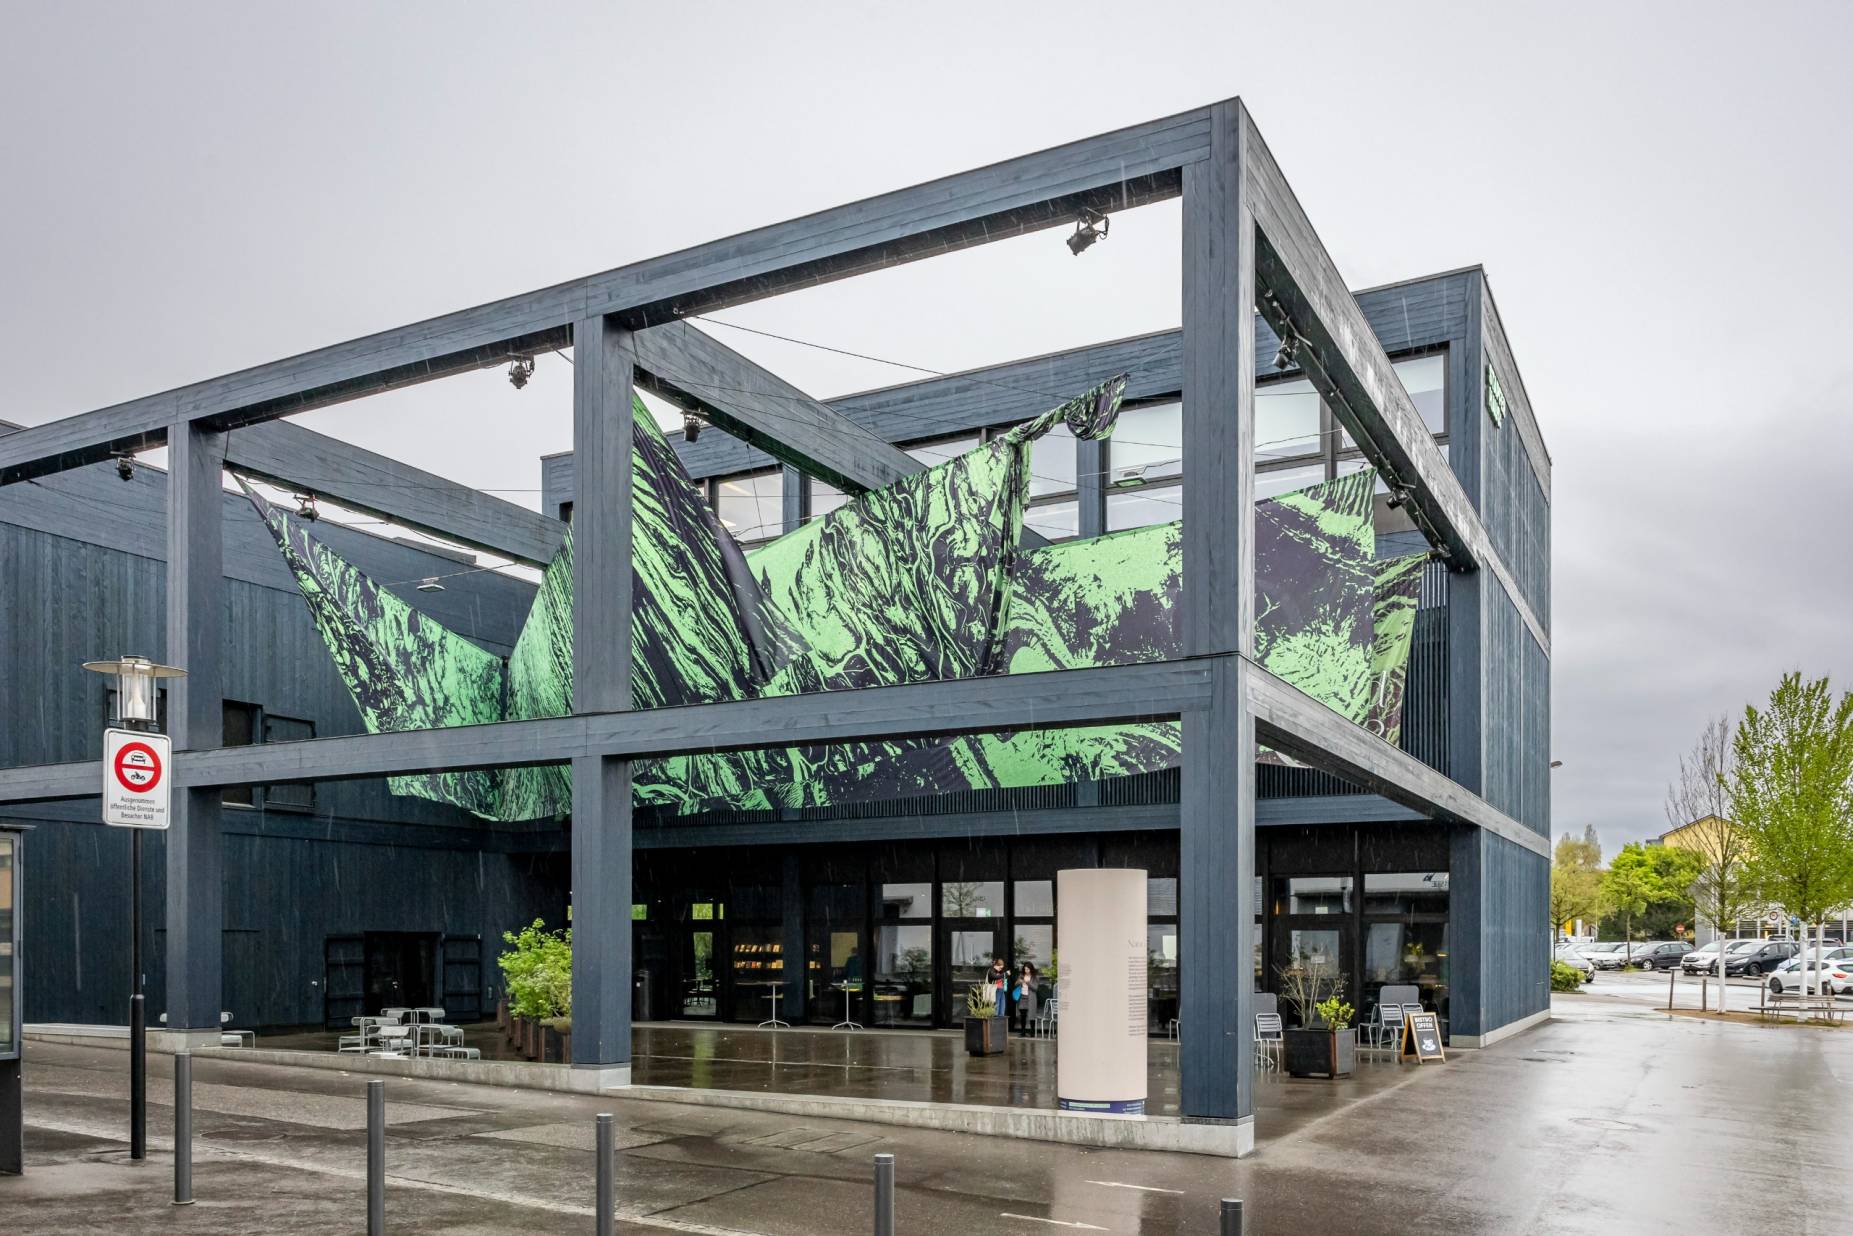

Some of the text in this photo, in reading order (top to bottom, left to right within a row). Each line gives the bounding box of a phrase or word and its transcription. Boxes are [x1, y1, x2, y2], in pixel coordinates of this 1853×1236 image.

[120, 795, 155, 804] Ausgenommen
[110, 803, 136, 811] öffentliche
[137, 805, 154, 813] Dienste
[121, 811, 143, 819] Besucher
